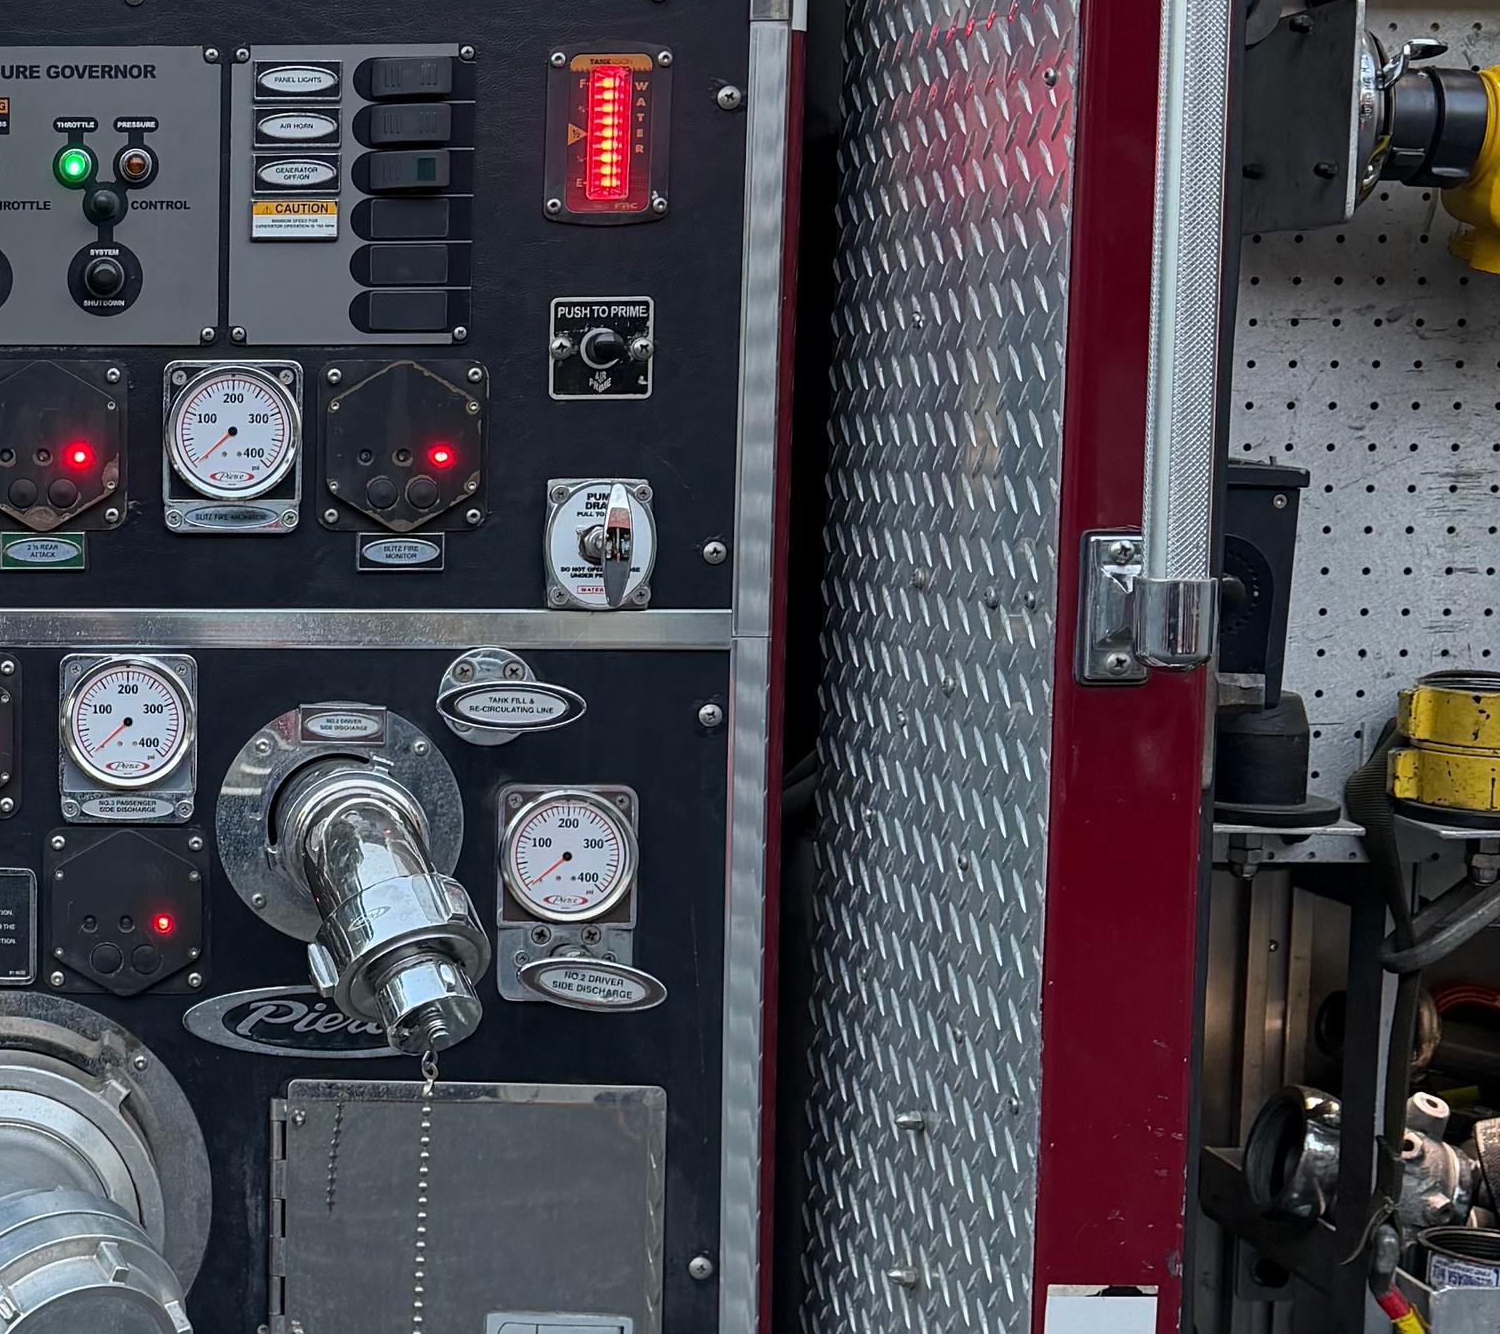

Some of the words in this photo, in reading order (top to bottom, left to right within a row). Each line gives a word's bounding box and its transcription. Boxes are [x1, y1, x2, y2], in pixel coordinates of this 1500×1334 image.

[46, 65, 156, 79] GOVERNOR
[131, 201, 190, 210] CONTROL
[276, 204, 328, 213] CAUTION
[558, 307, 589, 318] PUSH
[592, 306, 608, 317] TO
[611, 306, 648, 317] PRIME
[223, 394, 244, 403] 200
[198, 414, 217, 423] 100
[248, 414, 269, 423] 300
[243, 448, 264, 458] 400
[118, 684, 138, 694] 200
[93, 704, 112, 714] 100
[143, 704, 163, 714] 300
[469, 705, 534, 714] RE-CIRCULATING
[139, 738, 159, 747] 400
[558, 818, 579, 828] 200
[532, 838, 551, 847] 100
[583, 839, 604, 848] 300
[578, 872, 598, 882] 400
[564, 971, 586, 981] NO.2
[588, 974, 624, 987] DRIVER
[552, 981, 574, 992] SIDE
[576, 983, 633, 999] DISCHARGE
